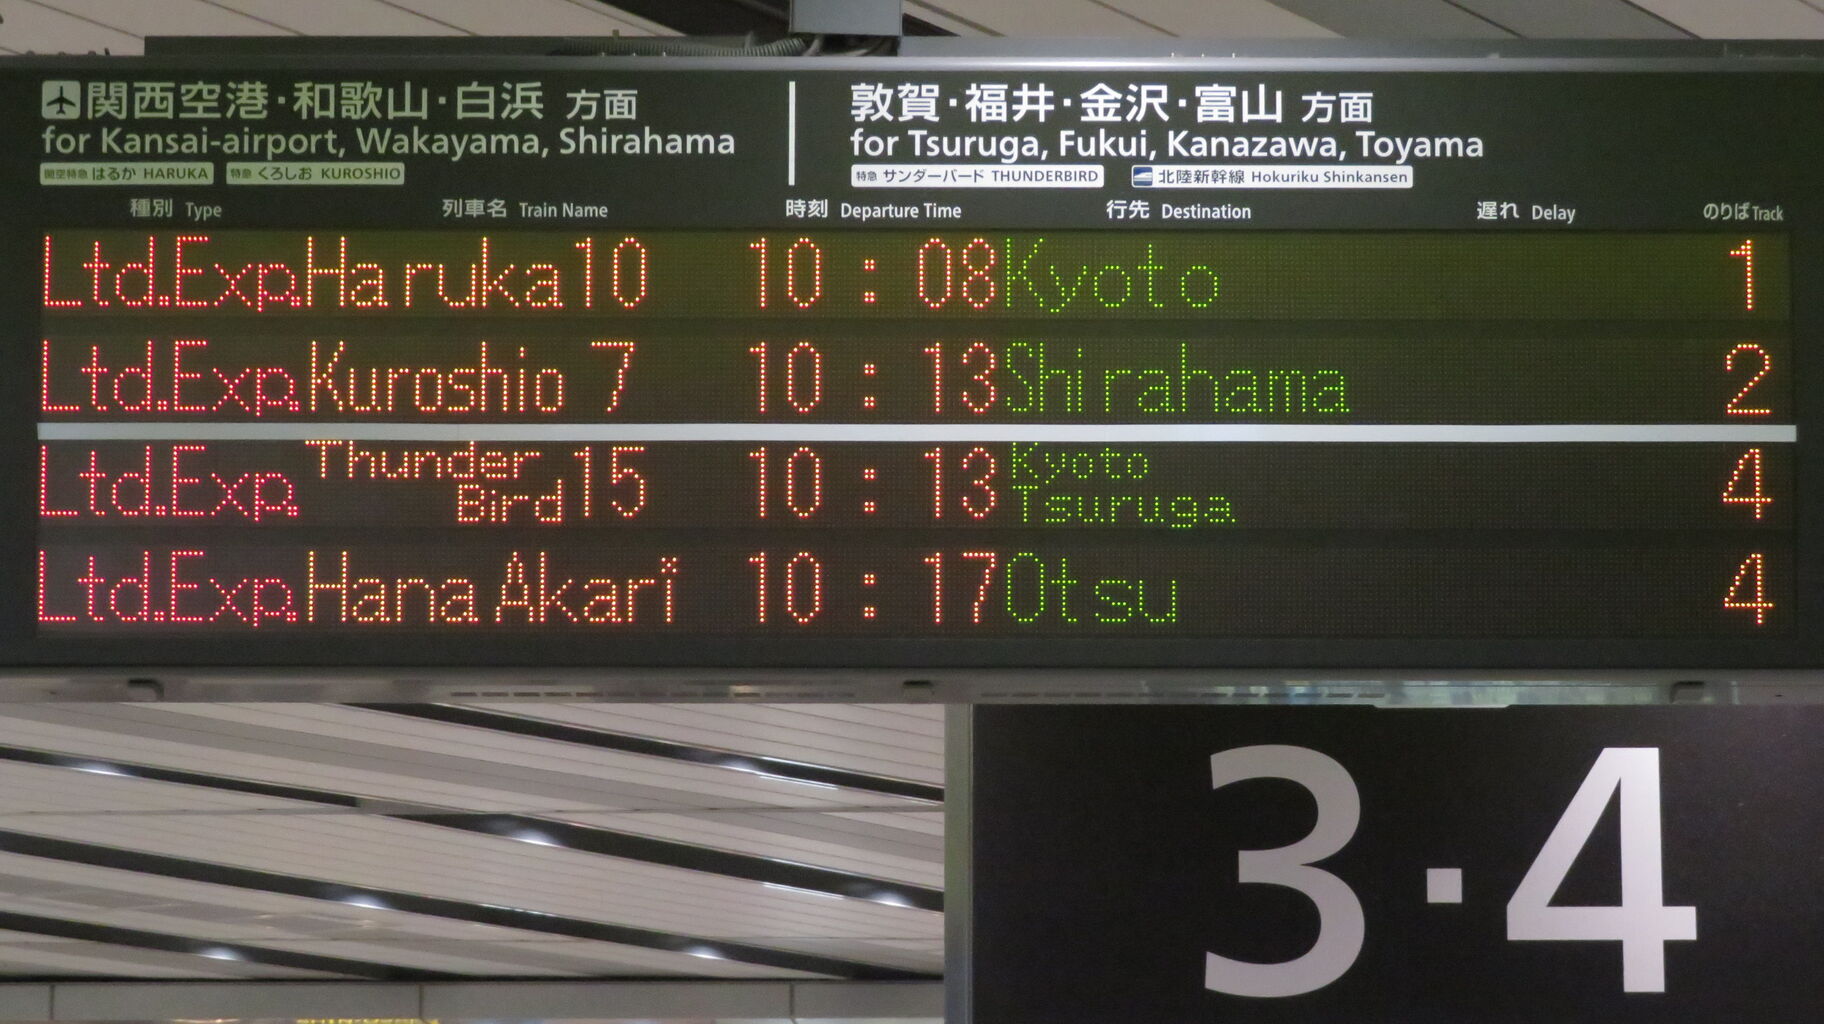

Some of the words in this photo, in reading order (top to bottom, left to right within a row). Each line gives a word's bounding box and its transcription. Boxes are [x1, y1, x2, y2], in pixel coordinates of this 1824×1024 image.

[87, 80, 545, 120] 関西空港・和歌山・白浜
[565, 88, 638, 120] 方面
[850, 82, 1284, 123] 敦賀・福井・金沢・富山
[1301, 91, 1375, 123] 方面
[40, 124, 92, 155] for
[101, 126, 346, 160] Kansai-airport,
[356, 126, 549, 161] Wakayama,
[559, 126, 736, 155] Shirahama
[850, 128, 899, 157] for
[908, 129, 1048, 163] Tsuruga,
[1059, 129, 1157, 160] Fukui,
[1167, 129, 1347, 161] Kanazawa,
[1355, 130, 1484, 163] Toyama
[92, 167, 136, 181] はるか
[143, 167, 209, 181] HARUKA
[231, 168, 252, 180] 特急
[257, 167, 313, 181] くろしお
[320, 167, 401, 181] KUROSHIO
[856, 170, 878, 182] 特急
[882, 168, 985, 184] サンダーバード
[991, 169, 1099, 183] THUNDERBIRD
[1158, 169, 1246, 186] 北陸新幹線
[1251, 171, 1319, 184] Hokuriku
[1324, 171, 1408, 185] Shinkansen
[129, 198, 174, 218] 種別
[184, 201, 223, 221] Type
[441, 199, 508, 219] 列車名
[518, 201, 557, 219] Train
[562, 201, 609, 219] Name
[785, 199, 829, 220] 時刻
[840, 202, 919, 222] Departure
[922, 202, 963, 220] Time
[1105, 200, 1151, 221] 行先
[1161, 203, 1253, 221] Destination
[1476, 201, 1521, 221] 遅れ
[1531, 204, 1577, 225] Delay
[1702, 202, 1750, 221] のりば
[1753, 205, 1785, 222] Track
[305, 234, 566, 308] Haruka
[1004, 236, 1222, 314] Kyoto
[1729, 237, 1755, 311] 1
[308, 339, 566, 413] Kuroshio
[588, 340, 638, 413] 7
[1004, 341, 1351, 414] Shirahama
[1725, 342, 1773, 415] 2
[302, 438, 544, 481] Thunder
[571, 445, 648, 520] 15
[1010, 441, 1149, 485] Kyoto
[1721, 447, 1775, 521] 4
[456, 476, 564, 523] Bird
[1011, 484, 1237, 529] Tsuruga
[306, 550, 482, 623] Hana
[1005, 550, 1178, 624] Otsu
[1722, 552, 1777, 625] 4
